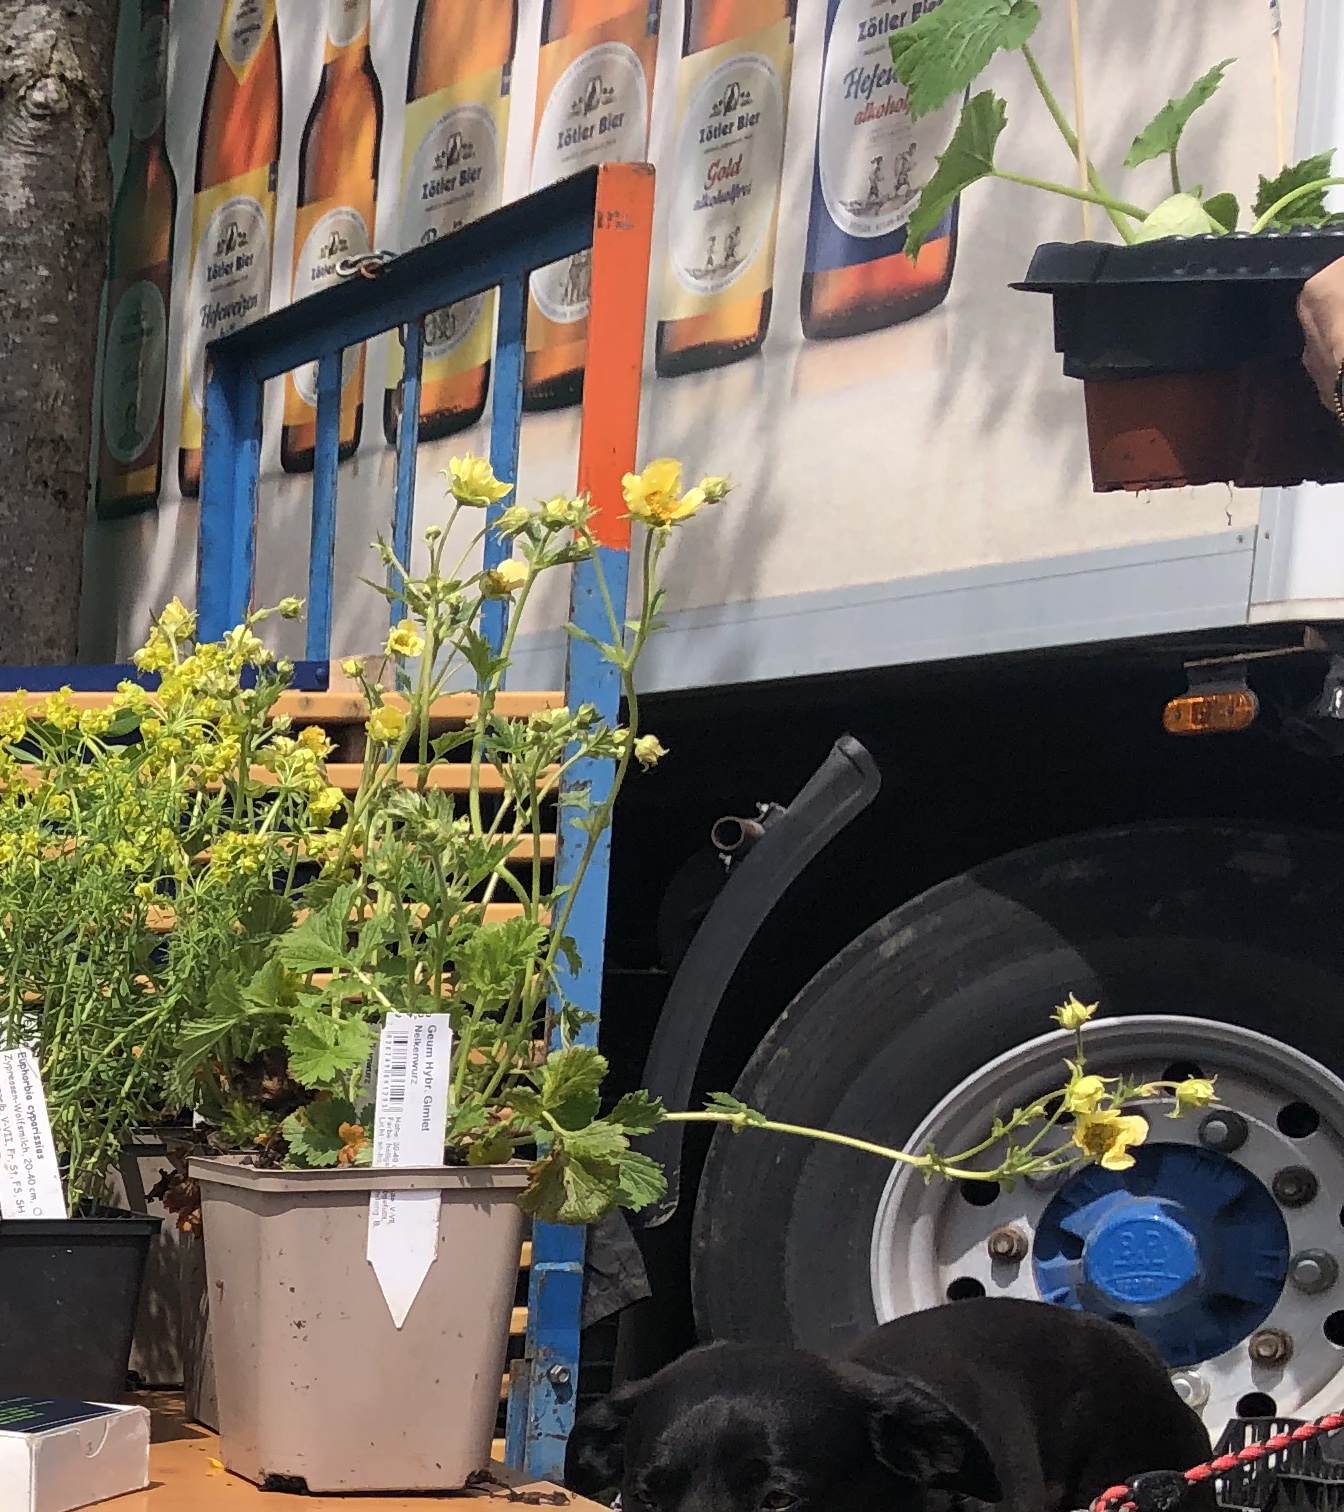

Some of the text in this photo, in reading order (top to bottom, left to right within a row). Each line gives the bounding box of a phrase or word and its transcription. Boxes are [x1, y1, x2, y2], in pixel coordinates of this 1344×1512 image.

[858, 11, 906, 42] Zötler
[557, 123, 596, 150] Zötler
[599, 112, 624, 134] Bier
[699, 122, 733, 144] Zötler
[738, 111, 761, 131] Bier
[422, 166, 483, 199] Zötler Bier
[704, 154, 743, 190] Gold
[410, 1024, 422, 1085] Nelkenwurz
[425, 1024, 436, 1058] Geum
[15, 1051, 46, 1160] Euphorbia cyparissias
[421, 1095, 432, 1132] Gimlet
[22, 1157, 36, 1186] 20-40
